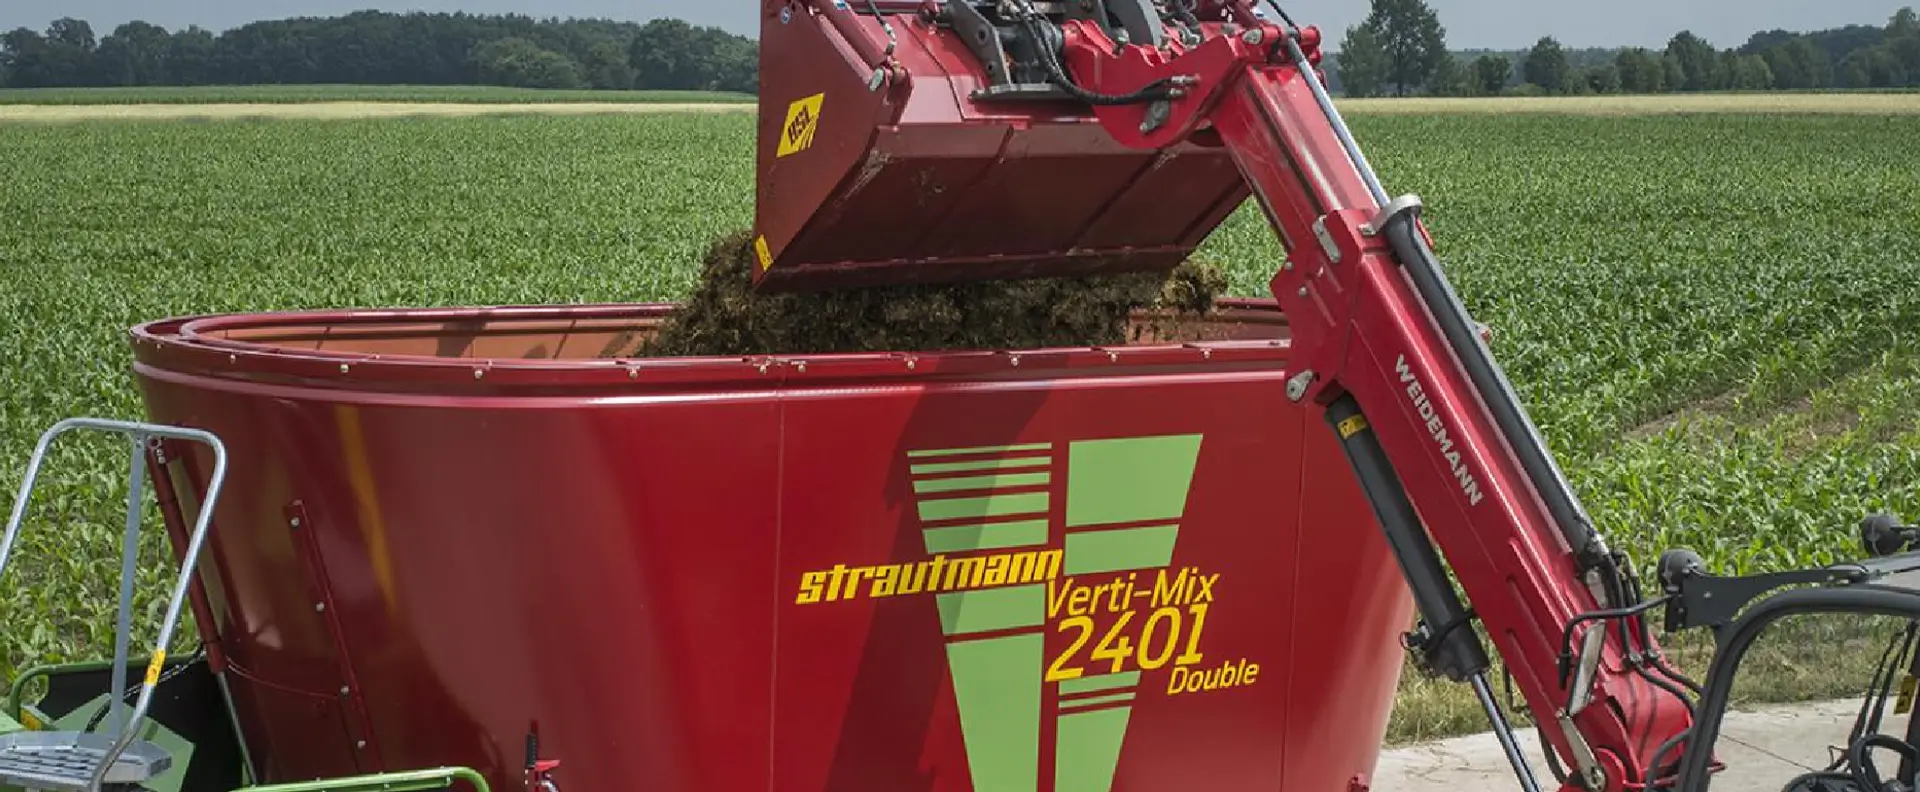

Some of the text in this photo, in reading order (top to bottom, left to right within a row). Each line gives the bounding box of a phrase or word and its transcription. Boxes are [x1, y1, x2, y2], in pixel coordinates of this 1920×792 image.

[1396, 354, 1483, 506] WEIDEMANN
[795, 548, 1063, 605] strautmann
[1046, 569, 1221, 619] Verti-Mix
[1045, 603, 1209, 682] 2401
[1166, 657, 1260, 695] Double
